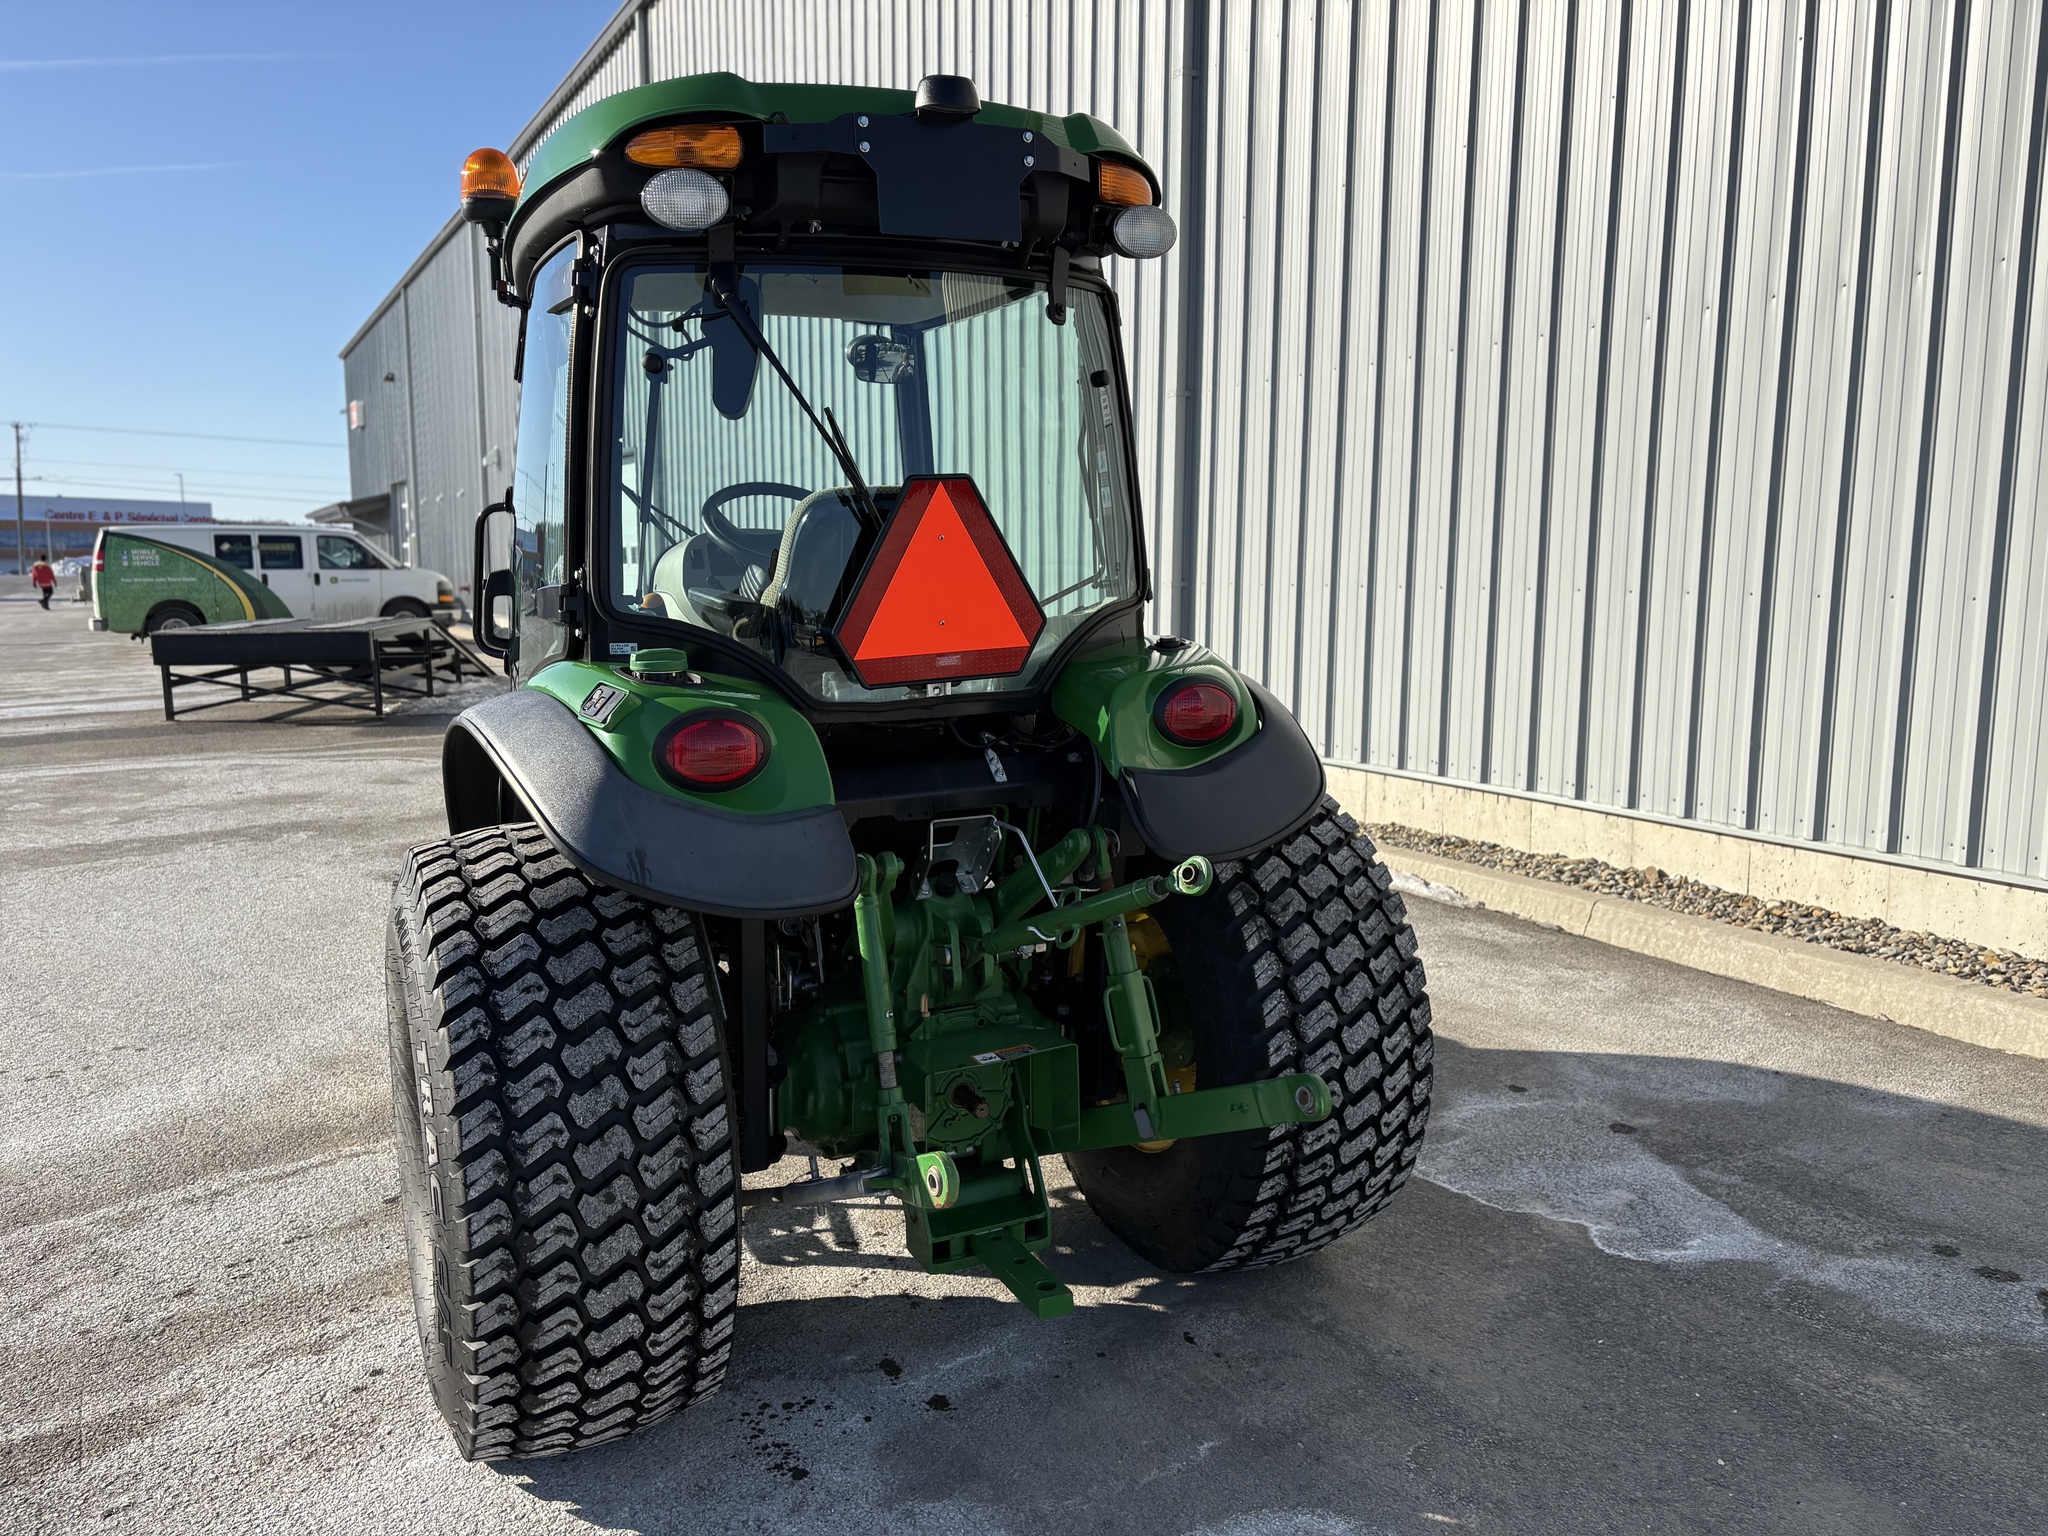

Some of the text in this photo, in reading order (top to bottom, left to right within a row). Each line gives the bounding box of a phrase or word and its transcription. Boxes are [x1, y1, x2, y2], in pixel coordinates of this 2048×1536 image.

[44, 509, 85, 521] Centre
[102, 511, 112, 522] &
[416, 1039, 446, 1227] TRAC
